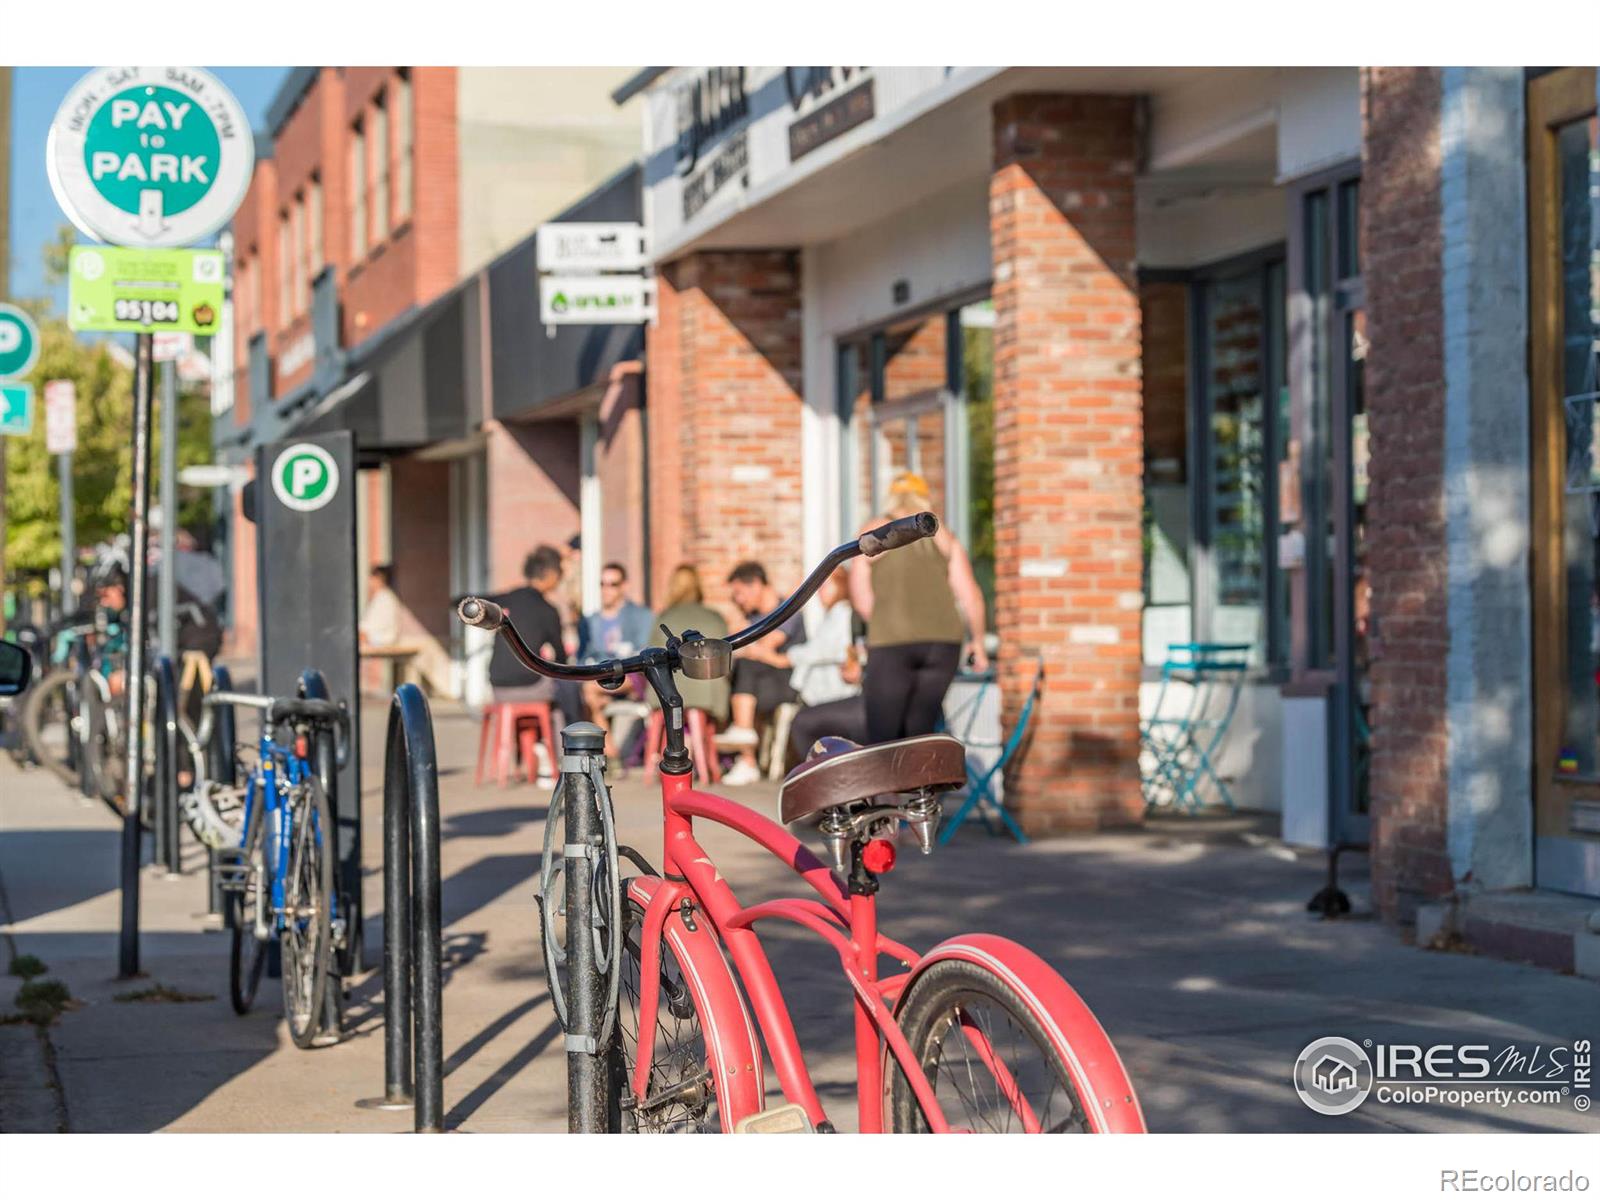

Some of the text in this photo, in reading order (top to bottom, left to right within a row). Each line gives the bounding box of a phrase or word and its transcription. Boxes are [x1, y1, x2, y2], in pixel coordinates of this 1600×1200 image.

[111, 99, 191, 130] PAY
[139, 133, 166, 149] to
[92, 152, 209, 183] PARK
[291, 458, 322, 497] P
